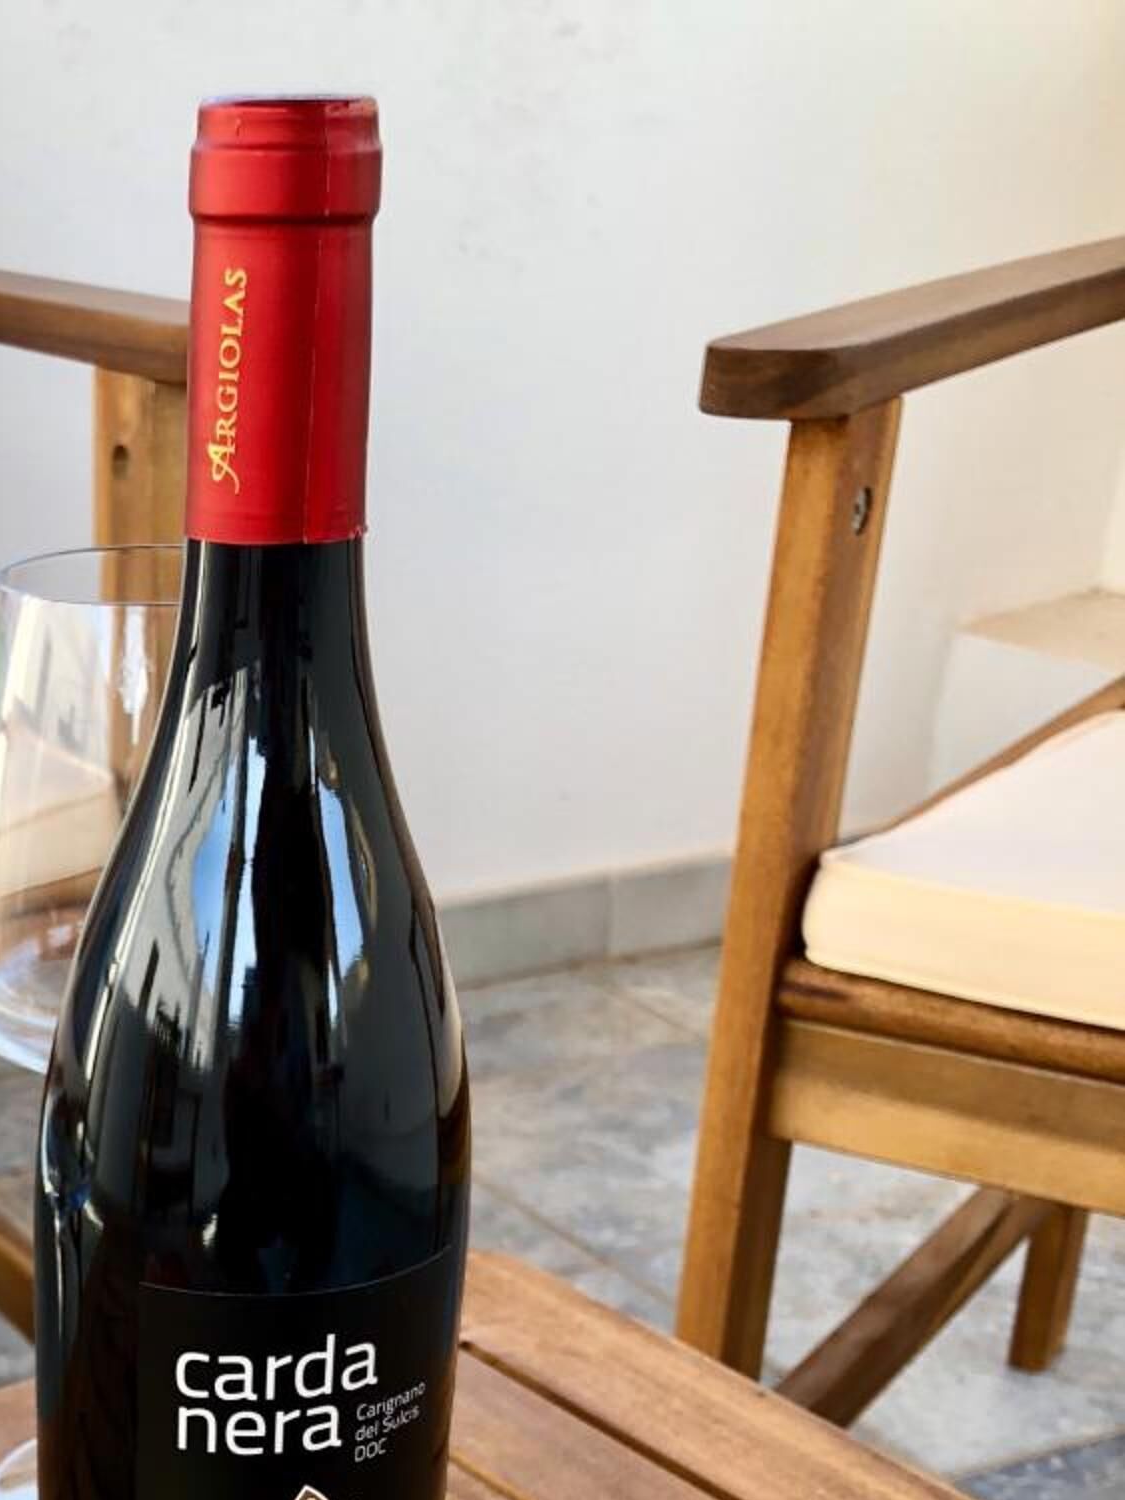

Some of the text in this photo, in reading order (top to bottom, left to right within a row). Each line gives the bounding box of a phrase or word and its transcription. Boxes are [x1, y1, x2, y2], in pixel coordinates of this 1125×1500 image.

[207, 267, 246, 494] ARGIOLAS
[175, 1333, 378, 1401] carda
[356, 1381, 426, 1421] Carignano
[177, 1405, 342, 1455] nera
[354, 1437, 387, 1462] DOC
[355, 1420, 378, 1441] del
